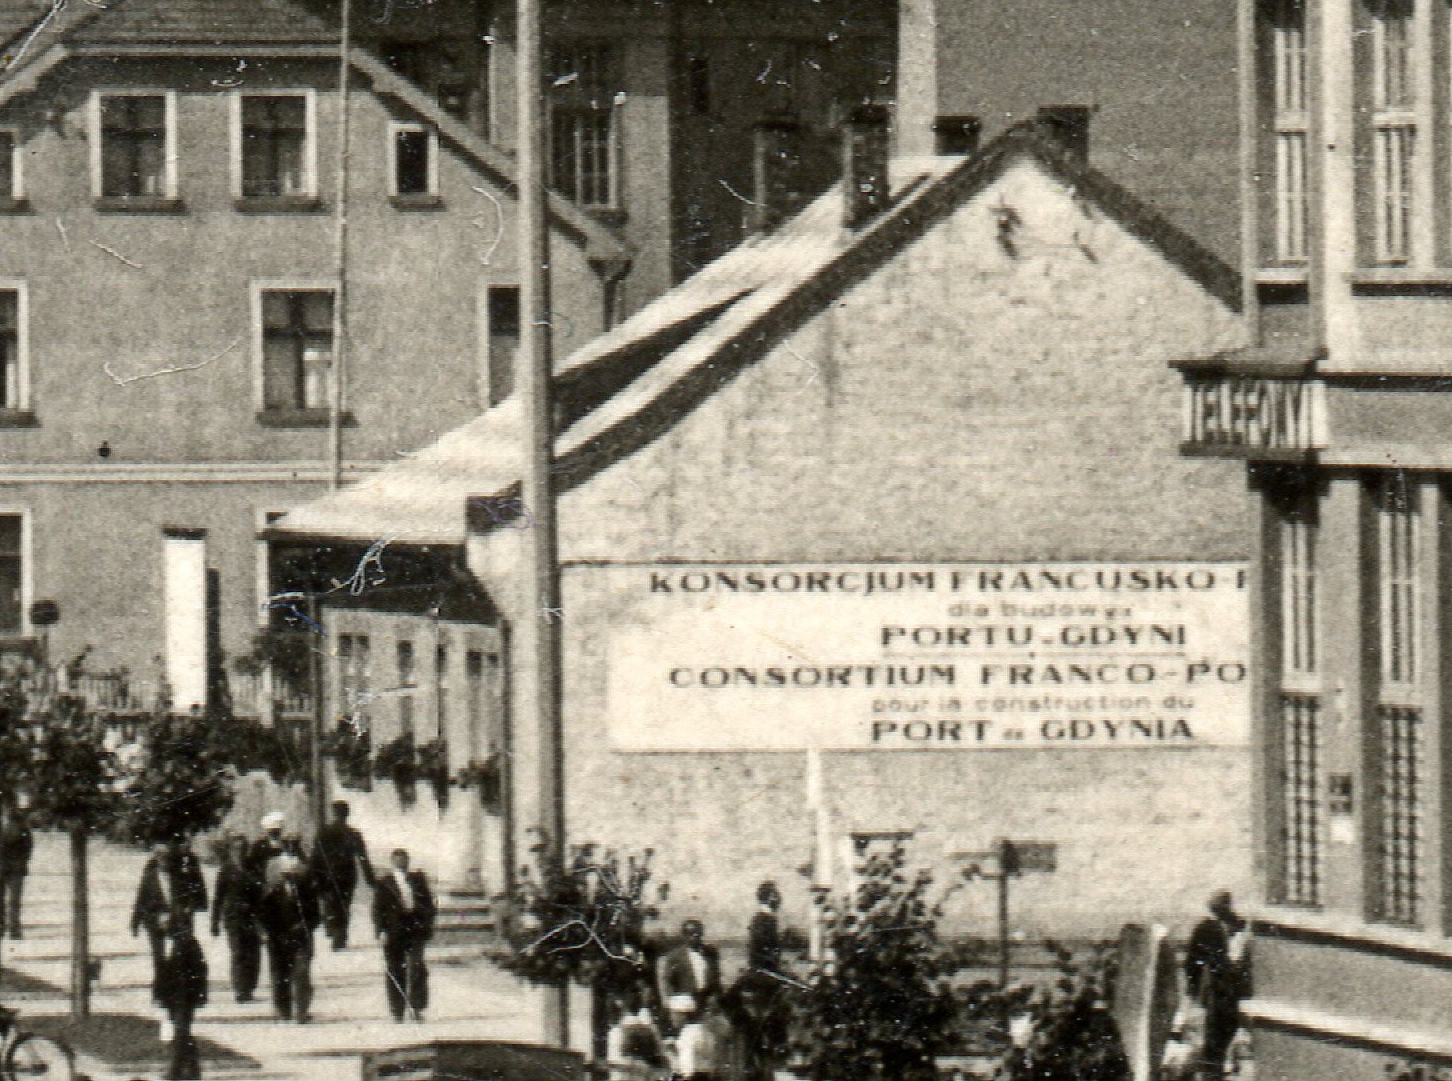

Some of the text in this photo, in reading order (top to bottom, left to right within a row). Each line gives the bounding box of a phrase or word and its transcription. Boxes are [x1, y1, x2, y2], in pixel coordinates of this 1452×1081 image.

[650, 571, 935, 595] KONSORCJUM
[881, 625, 1034, 647] PORTU
[1059, 624, 1186, 646] GDYNI
[669, 664, 956, 688] CONSORTIUM
[872, 698, 930, 714] pour
[974, 695, 1152, 712] construction
[1161, 695, 1195, 710] du
[871, 719, 992, 742] PORT
[1040, 719, 1194, 741] GDYNIA
